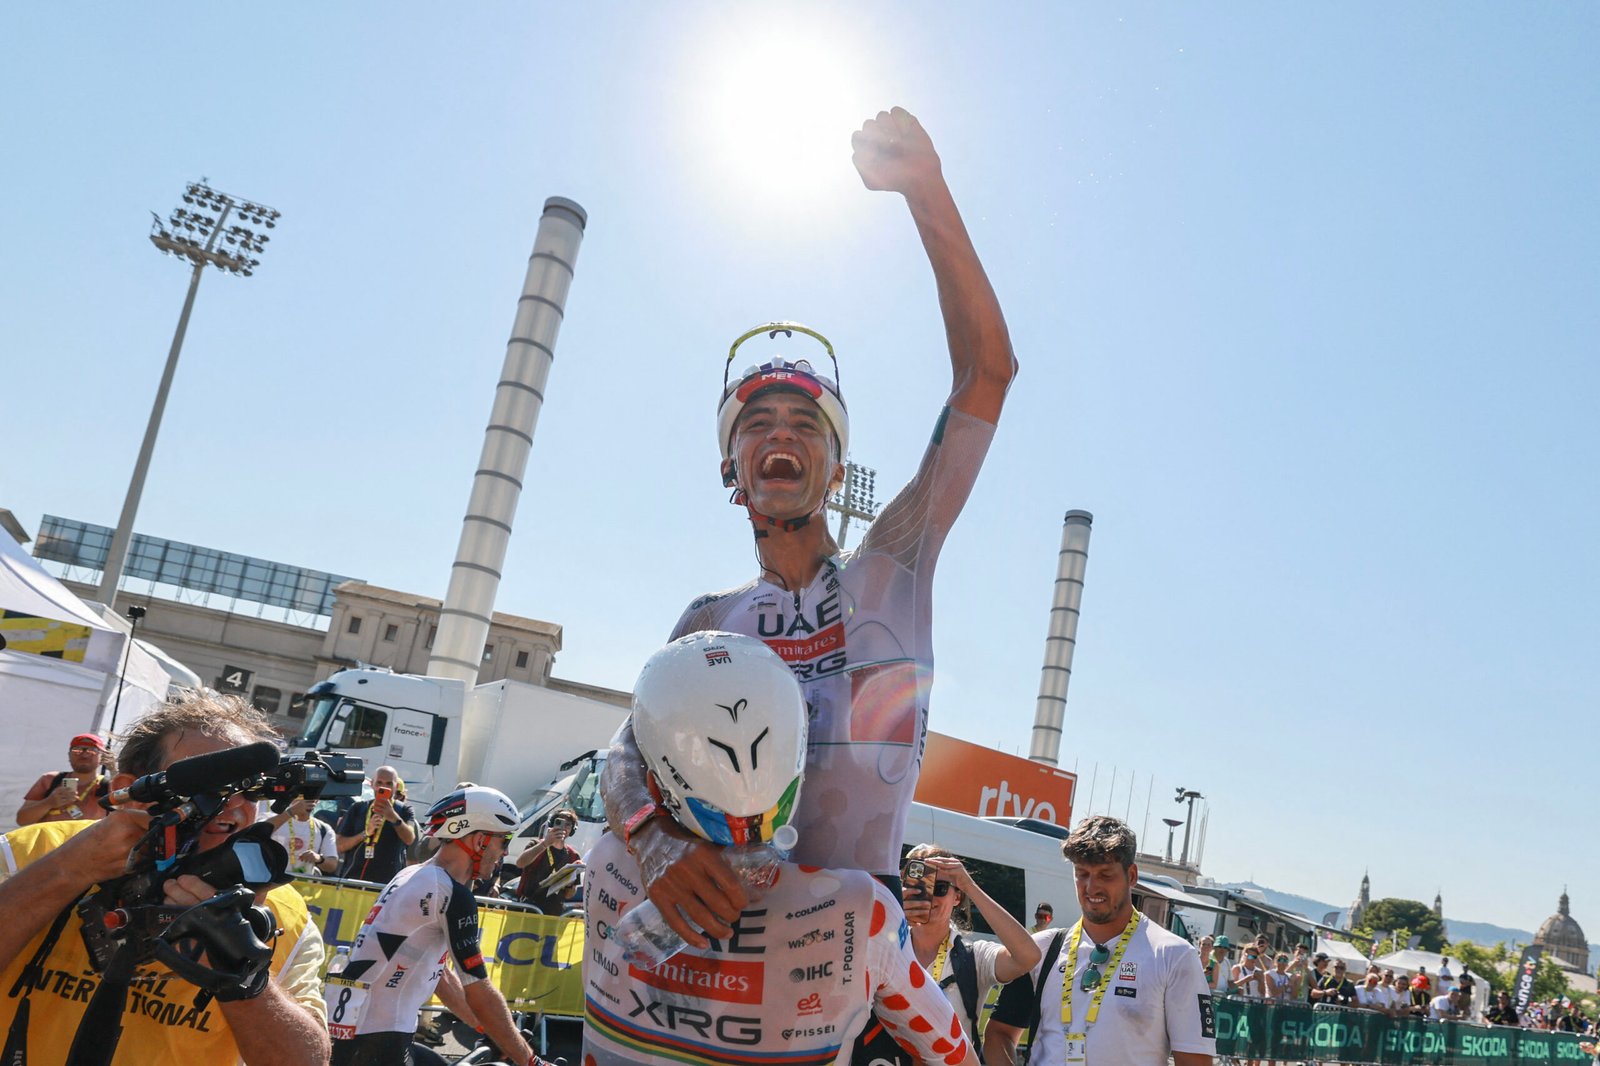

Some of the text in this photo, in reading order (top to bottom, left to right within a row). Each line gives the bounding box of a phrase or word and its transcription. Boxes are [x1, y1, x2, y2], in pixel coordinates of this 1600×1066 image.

[761, 371, 796, 381] MET
[758, 592, 842, 637] UAE
[768, 634, 838, 657] mirates
[708, 656, 732, 667] UAE
[788, 650, 847, 679] RG
[226, 671, 243, 687] 4
[662, 755, 693, 791] MET
[446, 806, 464, 815] MET
[447, 819, 470, 835] G42
[611, 868, 639, 896] Analog
[794, 899, 836, 918] COLNAGO
[843, 910, 855, 972] POGACAR
[593, 948, 619, 976] L'IMAD
[806, 960, 833, 981] IHC
[648, 961, 749, 992] mirates
[333, 987, 352, 1023] 8
[628, 988, 762, 1046] XRG
[795, 1025, 835, 1038] PISSEI
